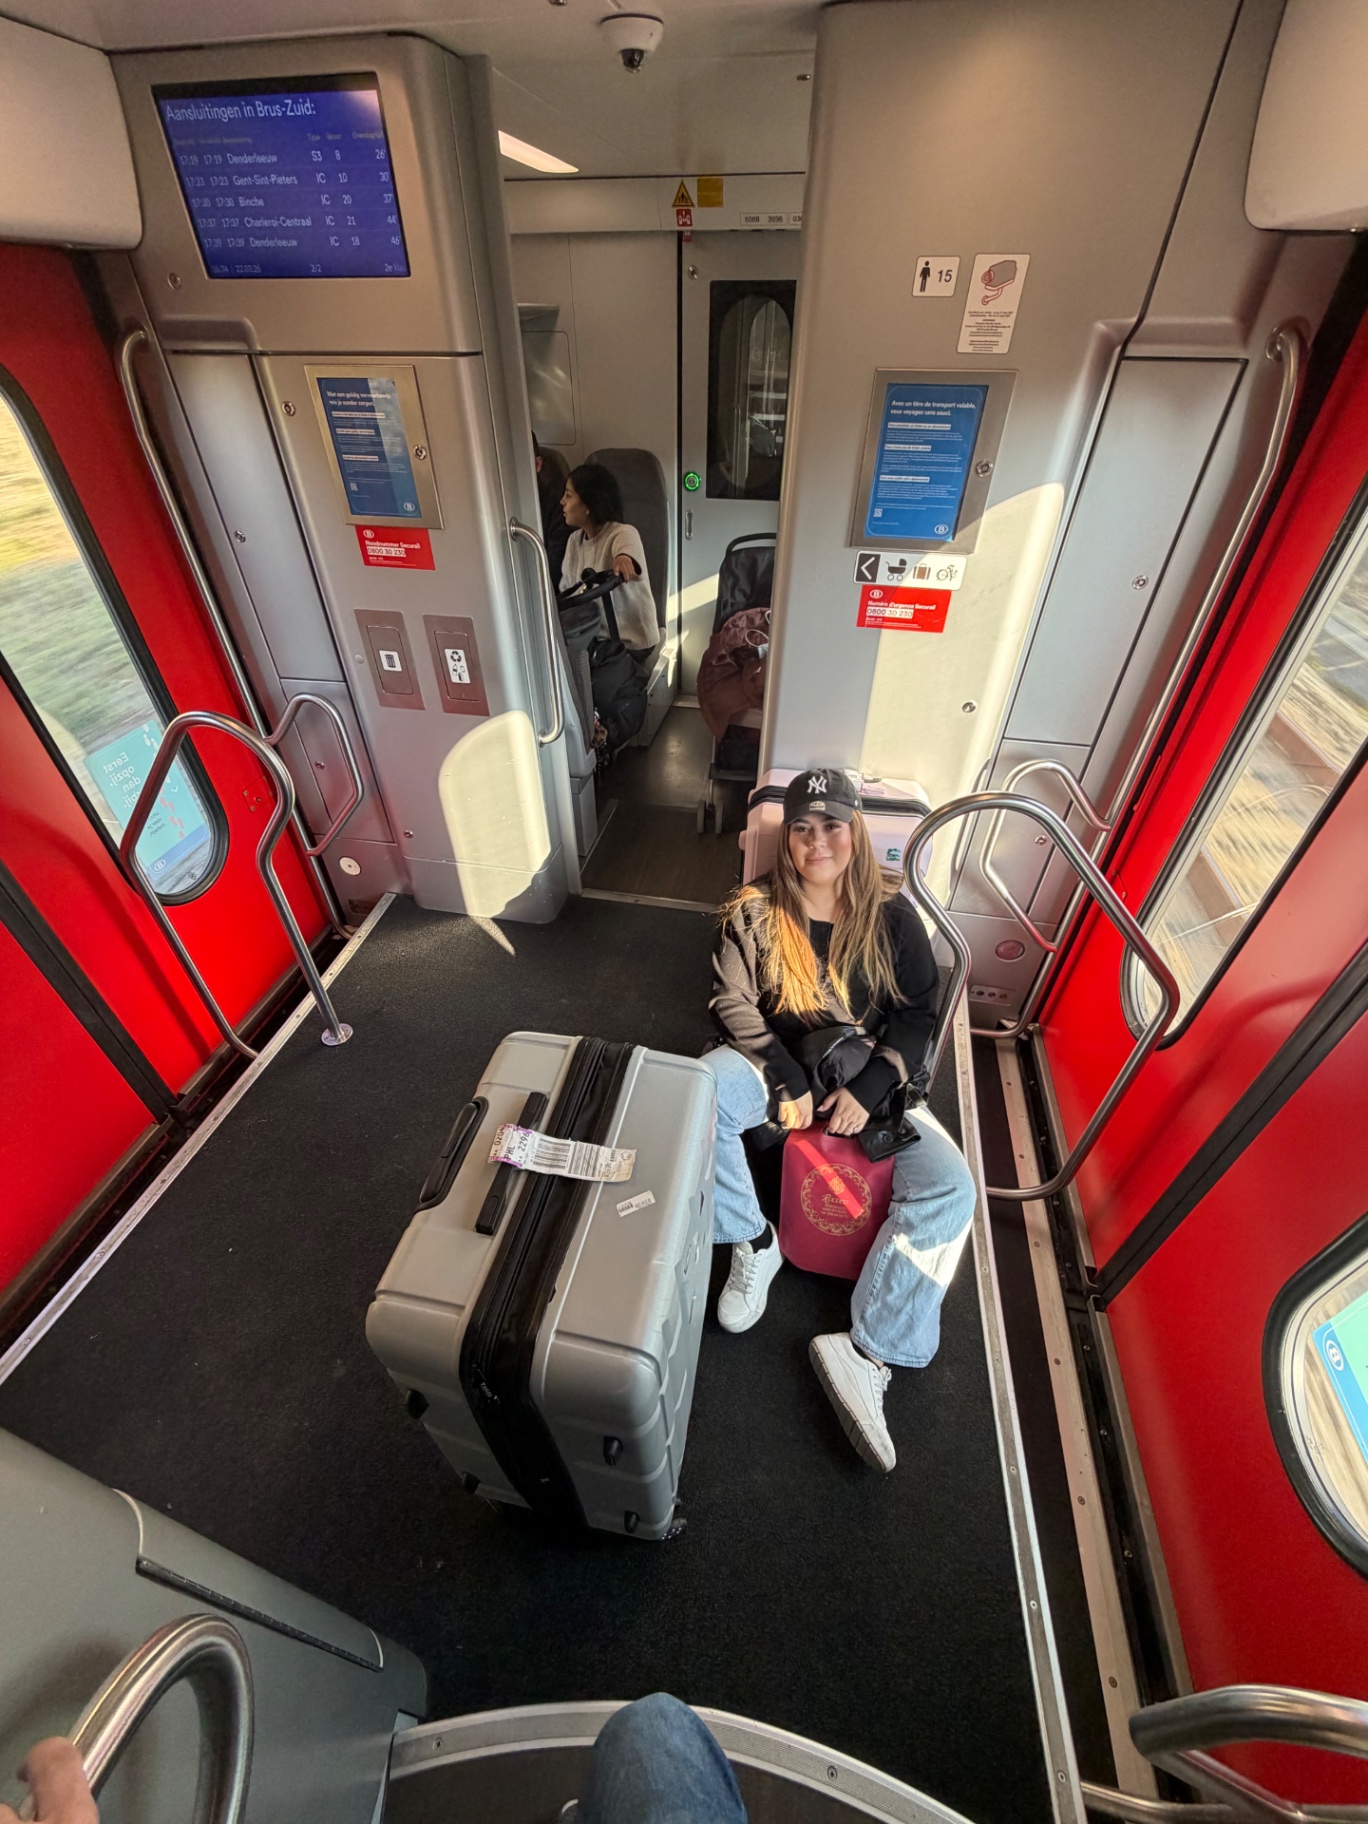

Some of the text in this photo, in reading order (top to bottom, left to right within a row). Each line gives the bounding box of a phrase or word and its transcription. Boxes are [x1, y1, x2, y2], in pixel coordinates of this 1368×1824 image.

[166, 98, 316, 123] Aansluitingen in Brus-Zuid:
[227, 152, 277, 164] Denderleeuw
[311, 150, 322, 161] S3
[233, 173, 298, 186] Gent-Sint-Pieters
[316, 172, 326, 183] IC
[338, 172, 348, 183] 10
[238, 196, 264, 207] Binche
[321, 194, 331, 205] IC
[342, 194, 352, 204] 20
[244, 215, 312, 227] Charleroi-Centraal
[325, 215, 335, 225] IC
[347, 216, 356, 225] 21
[249, 237, 298, 248] Denderleeuw
[330, 236, 339, 246] IC
[351, 236, 360, 246] 18
[310, 264, 322, 272] 2/2
[937, 269, 953, 283] 15
[932, 401, 956, 409] transport
[368, 547, 384, 555] 0800
[807, 775, 827, 794] NY
[504, 1146, 516, 1160] PHL
